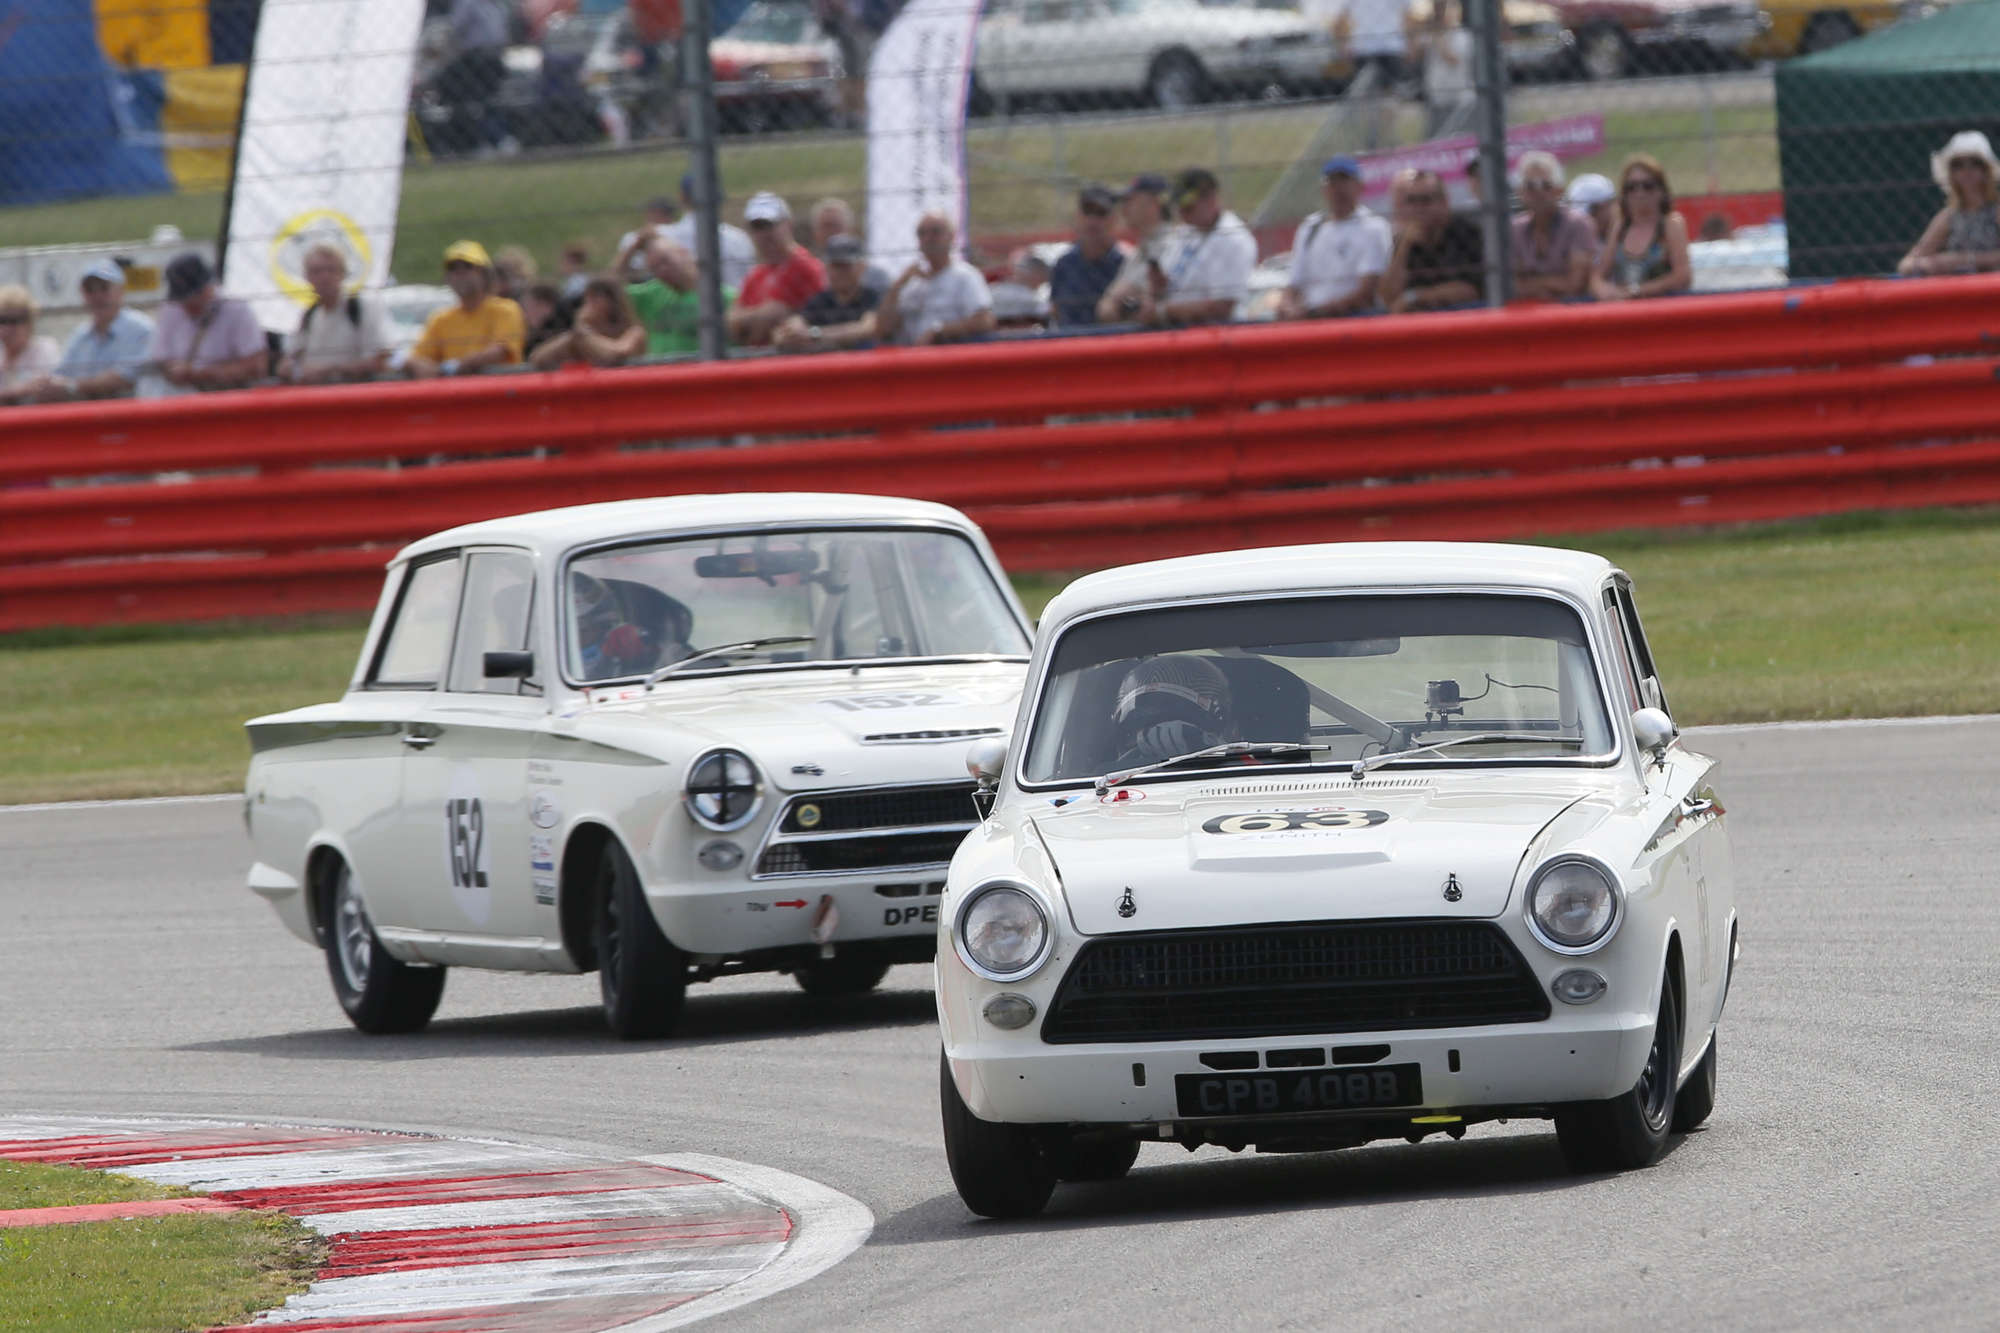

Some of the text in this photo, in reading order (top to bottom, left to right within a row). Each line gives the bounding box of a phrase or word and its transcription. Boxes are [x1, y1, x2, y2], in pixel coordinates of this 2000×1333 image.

[820, 693, 957, 712] 152
[1219, 811, 1371, 833] 63
[447, 798, 488, 888] 152
[885, 905, 937, 926] DPE
[1200, 1071, 1398, 1112] CPB 408B
